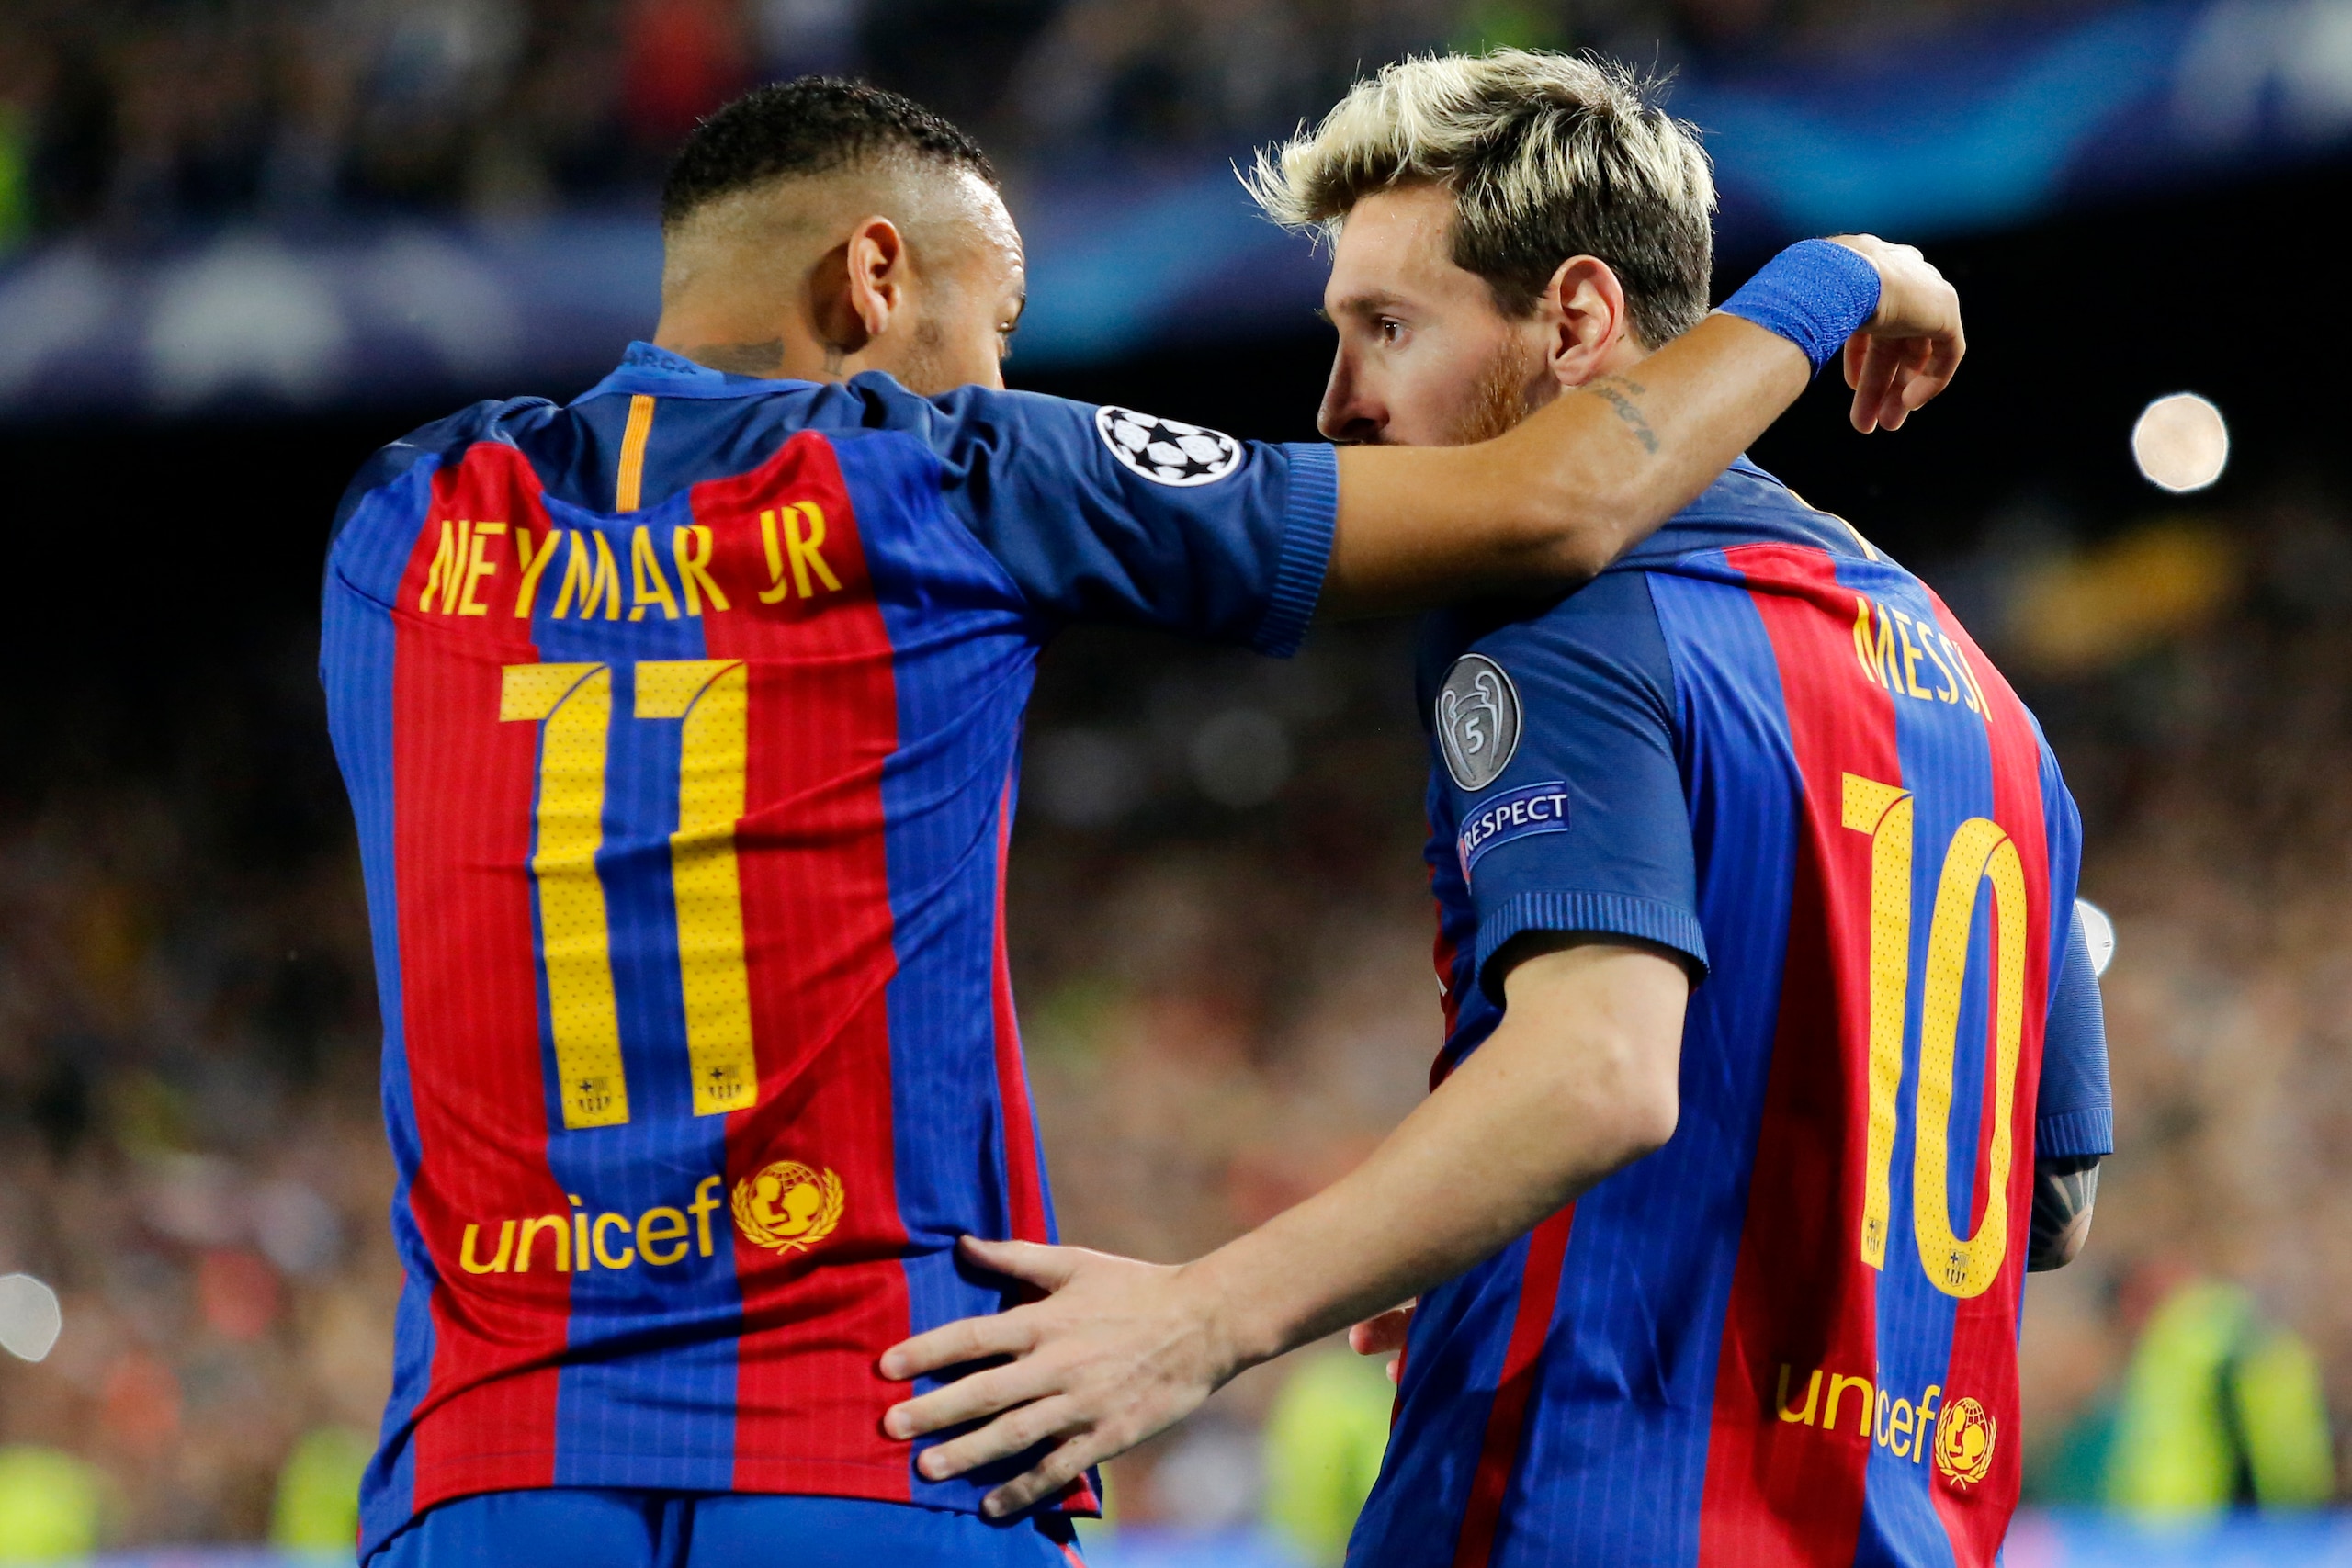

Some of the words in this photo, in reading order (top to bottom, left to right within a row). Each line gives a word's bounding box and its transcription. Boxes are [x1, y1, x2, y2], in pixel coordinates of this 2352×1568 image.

[419, 519, 731, 622] NEYMAR
[757, 500, 843, 604] JR
[1852, 596, 1993, 723] MESSI
[1464, 716, 1485, 754] 5
[1463, 793, 1568, 857] RESPECT
[499, 659, 759, 1130] 11
[1841, 771, 2029, 1300] 10
[460, 1174, 722, 1275] unicef
